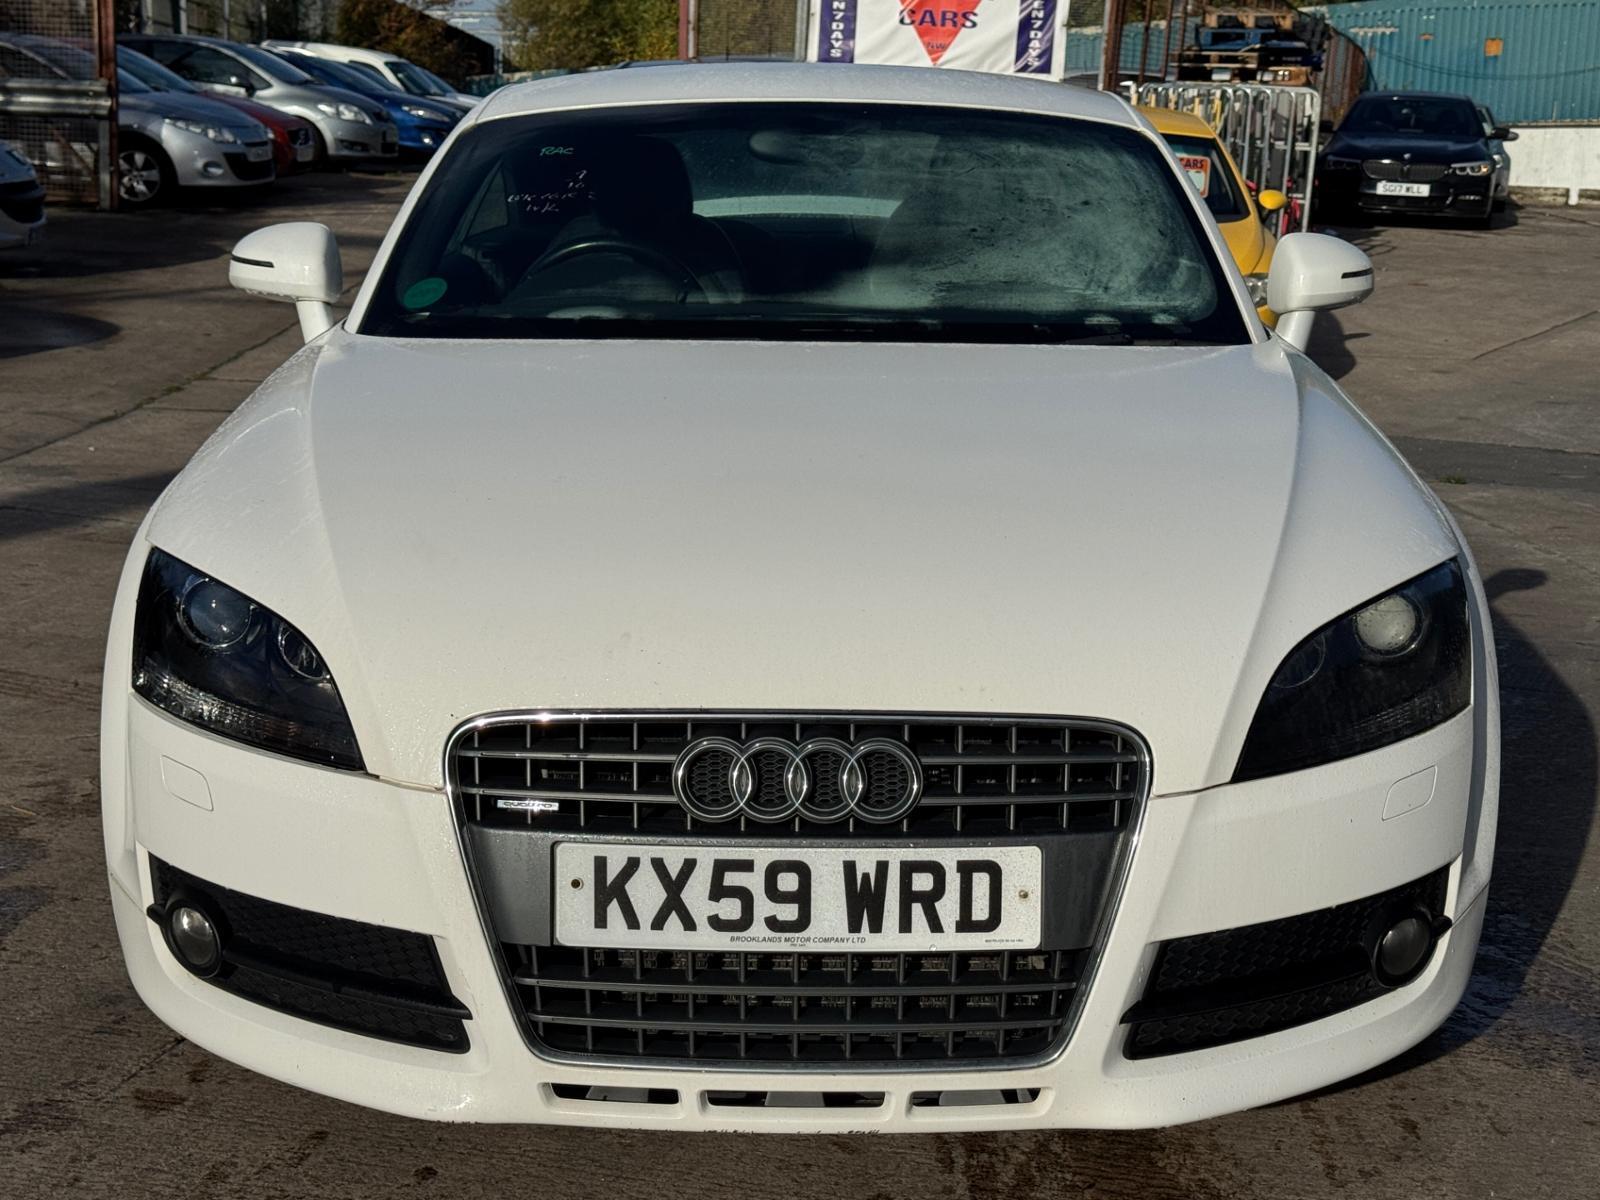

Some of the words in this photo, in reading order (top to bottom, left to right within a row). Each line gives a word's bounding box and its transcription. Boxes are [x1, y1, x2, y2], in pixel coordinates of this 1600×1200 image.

[899, 8, 978, 29] CARS
[593, 855, 812, 933] KX59
[842, 859, 1003, 934] WRD
[729, 935, 782, 943] BROOKLANDS
[812, 936, 850, 944] COMPANY
